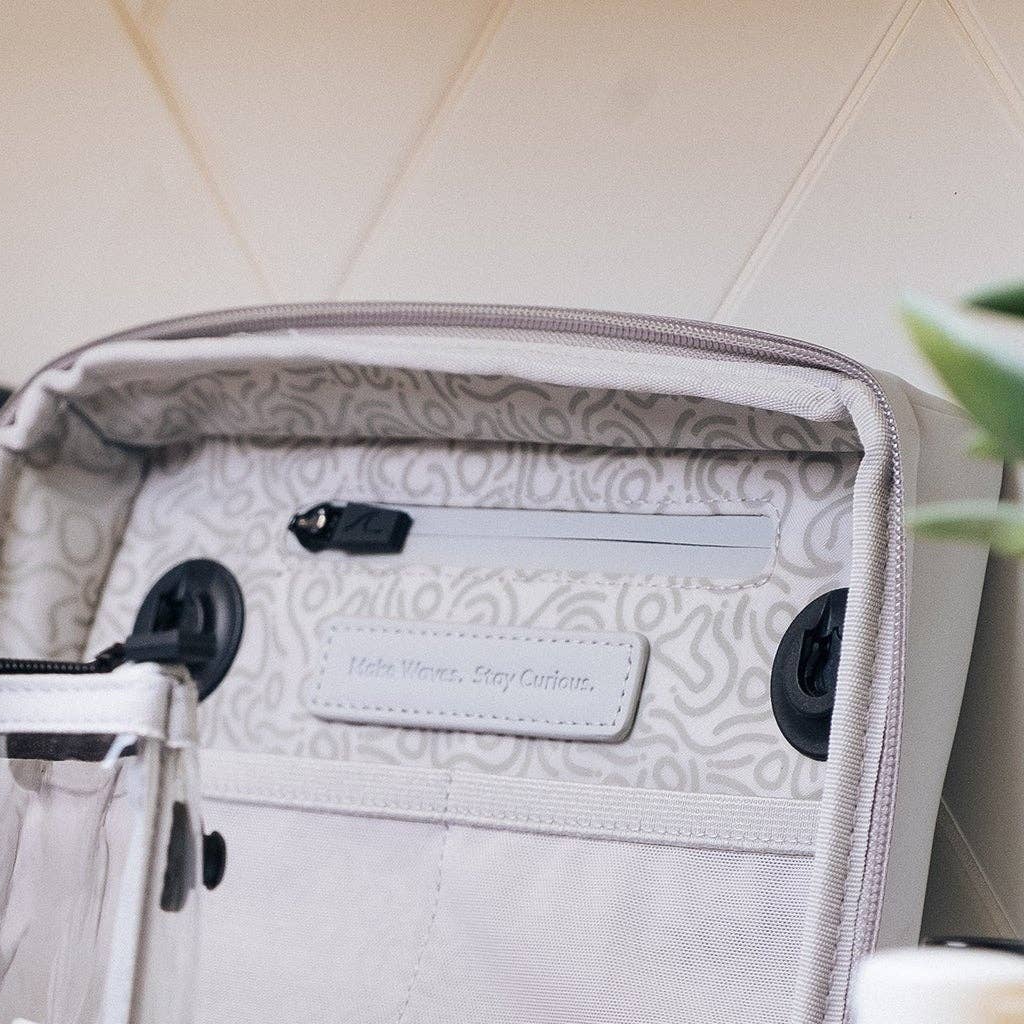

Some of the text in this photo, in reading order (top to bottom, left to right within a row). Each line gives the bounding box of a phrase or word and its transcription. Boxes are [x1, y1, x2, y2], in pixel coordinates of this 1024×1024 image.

[349, 655, 595, 693] Make Waves. Stay Curious.
